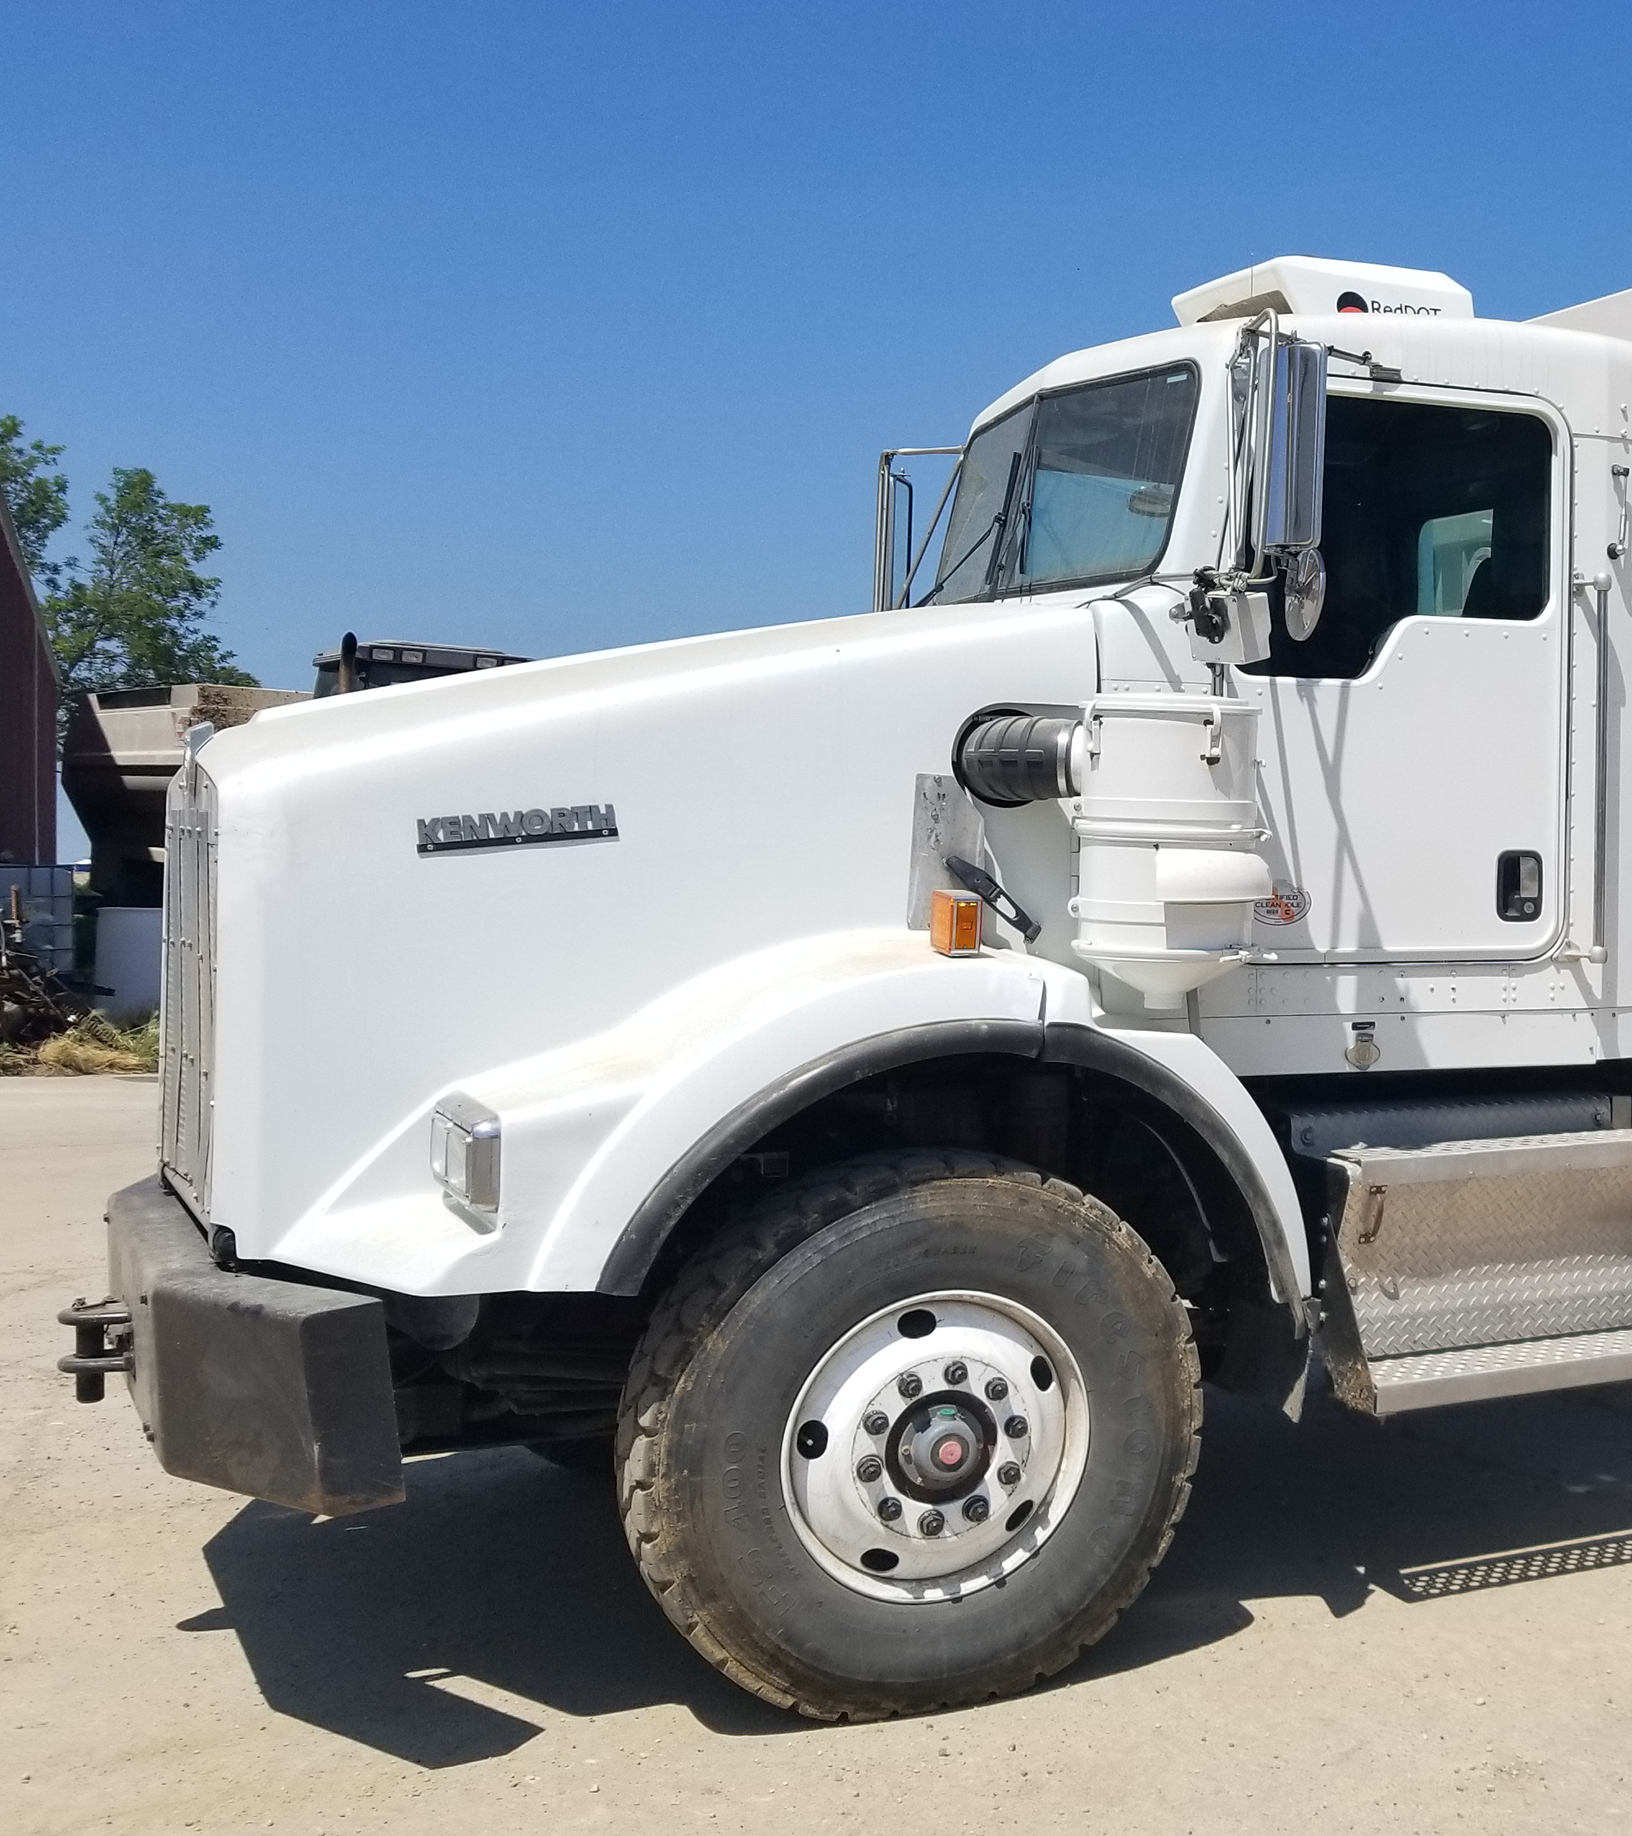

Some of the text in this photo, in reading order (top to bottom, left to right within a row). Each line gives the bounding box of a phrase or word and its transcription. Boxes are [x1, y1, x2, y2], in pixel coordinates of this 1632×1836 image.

[416, 803, 616, 844] KENWORTH
[1014, 1233, 1154, 1559] Firestone
[720, 1429, 750, 1533] 400
